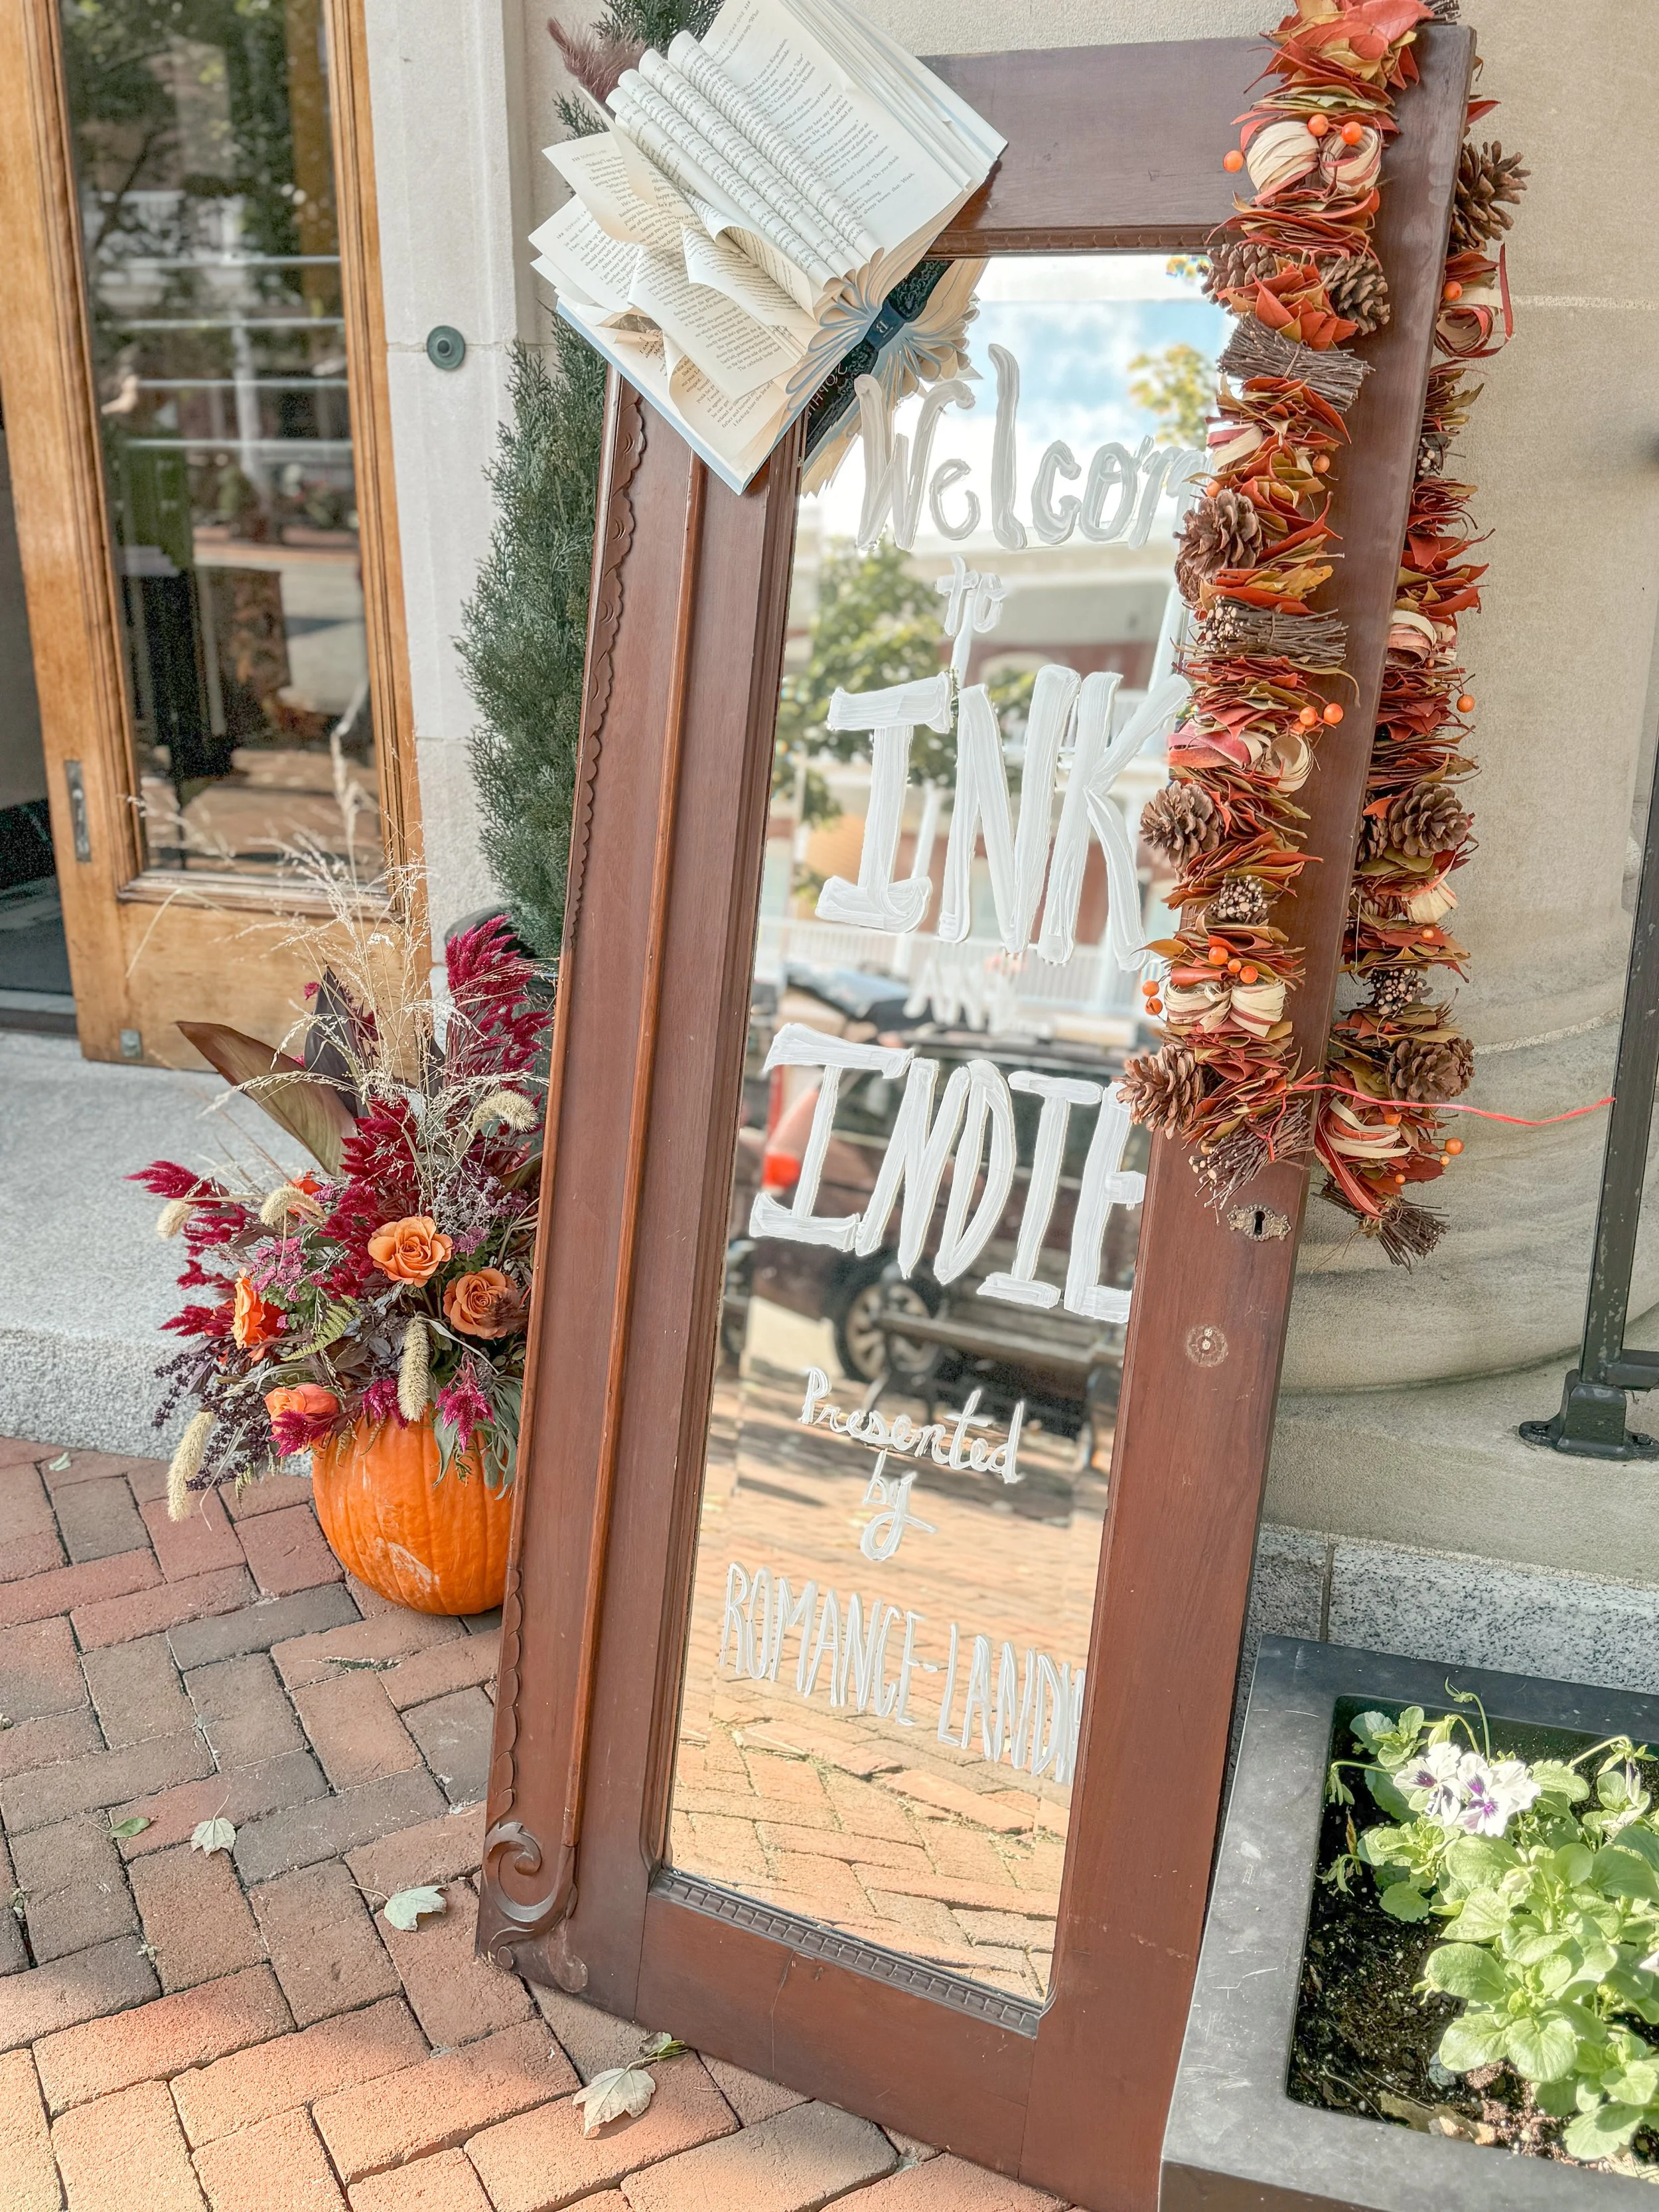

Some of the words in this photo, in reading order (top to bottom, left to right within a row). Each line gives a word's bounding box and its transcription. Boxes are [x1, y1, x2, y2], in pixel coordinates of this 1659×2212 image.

[853, 342, 1218, 552] Welcom
[815, 664, 1192, 971] INK
[749, 1022, 1145, 1323] INDIE
[800, 1367, 1025, 1484] Presented
[860, 1448, 938, 1562] by
